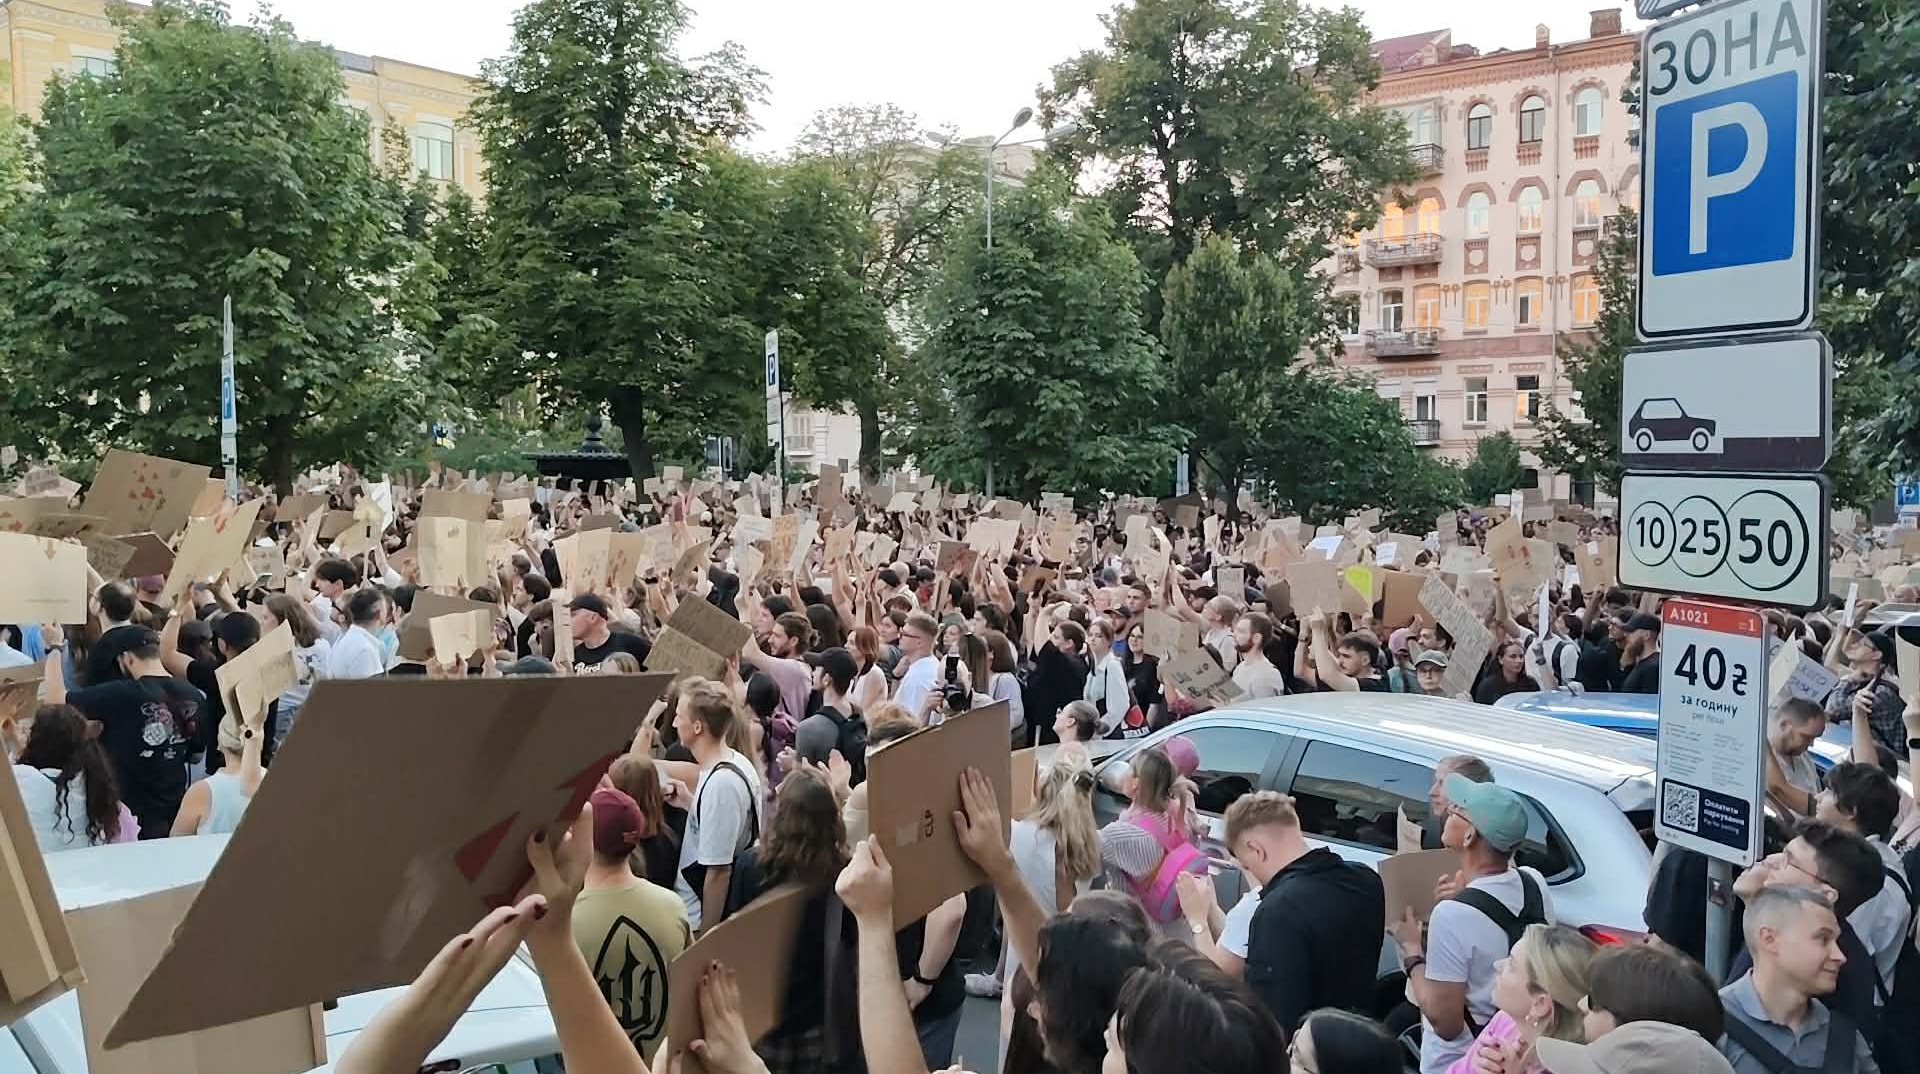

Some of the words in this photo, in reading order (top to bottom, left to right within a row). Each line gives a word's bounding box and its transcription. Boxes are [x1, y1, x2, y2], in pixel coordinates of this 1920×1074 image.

[1649, 1, 1806, 96] ЗОНА
[1689, 101, 1768, 255] P
[1636, 516, 1664, 548] 10
[1680, 517, 1720, 555] 25
[1739, 518, 1792, 566] 50
[1670, 606, 1709, 624] A1021
[1748, 619, 1756, 632] 1
[1681, 695, 1692, 705] за
[1696, 697, 1738, 718] годину
